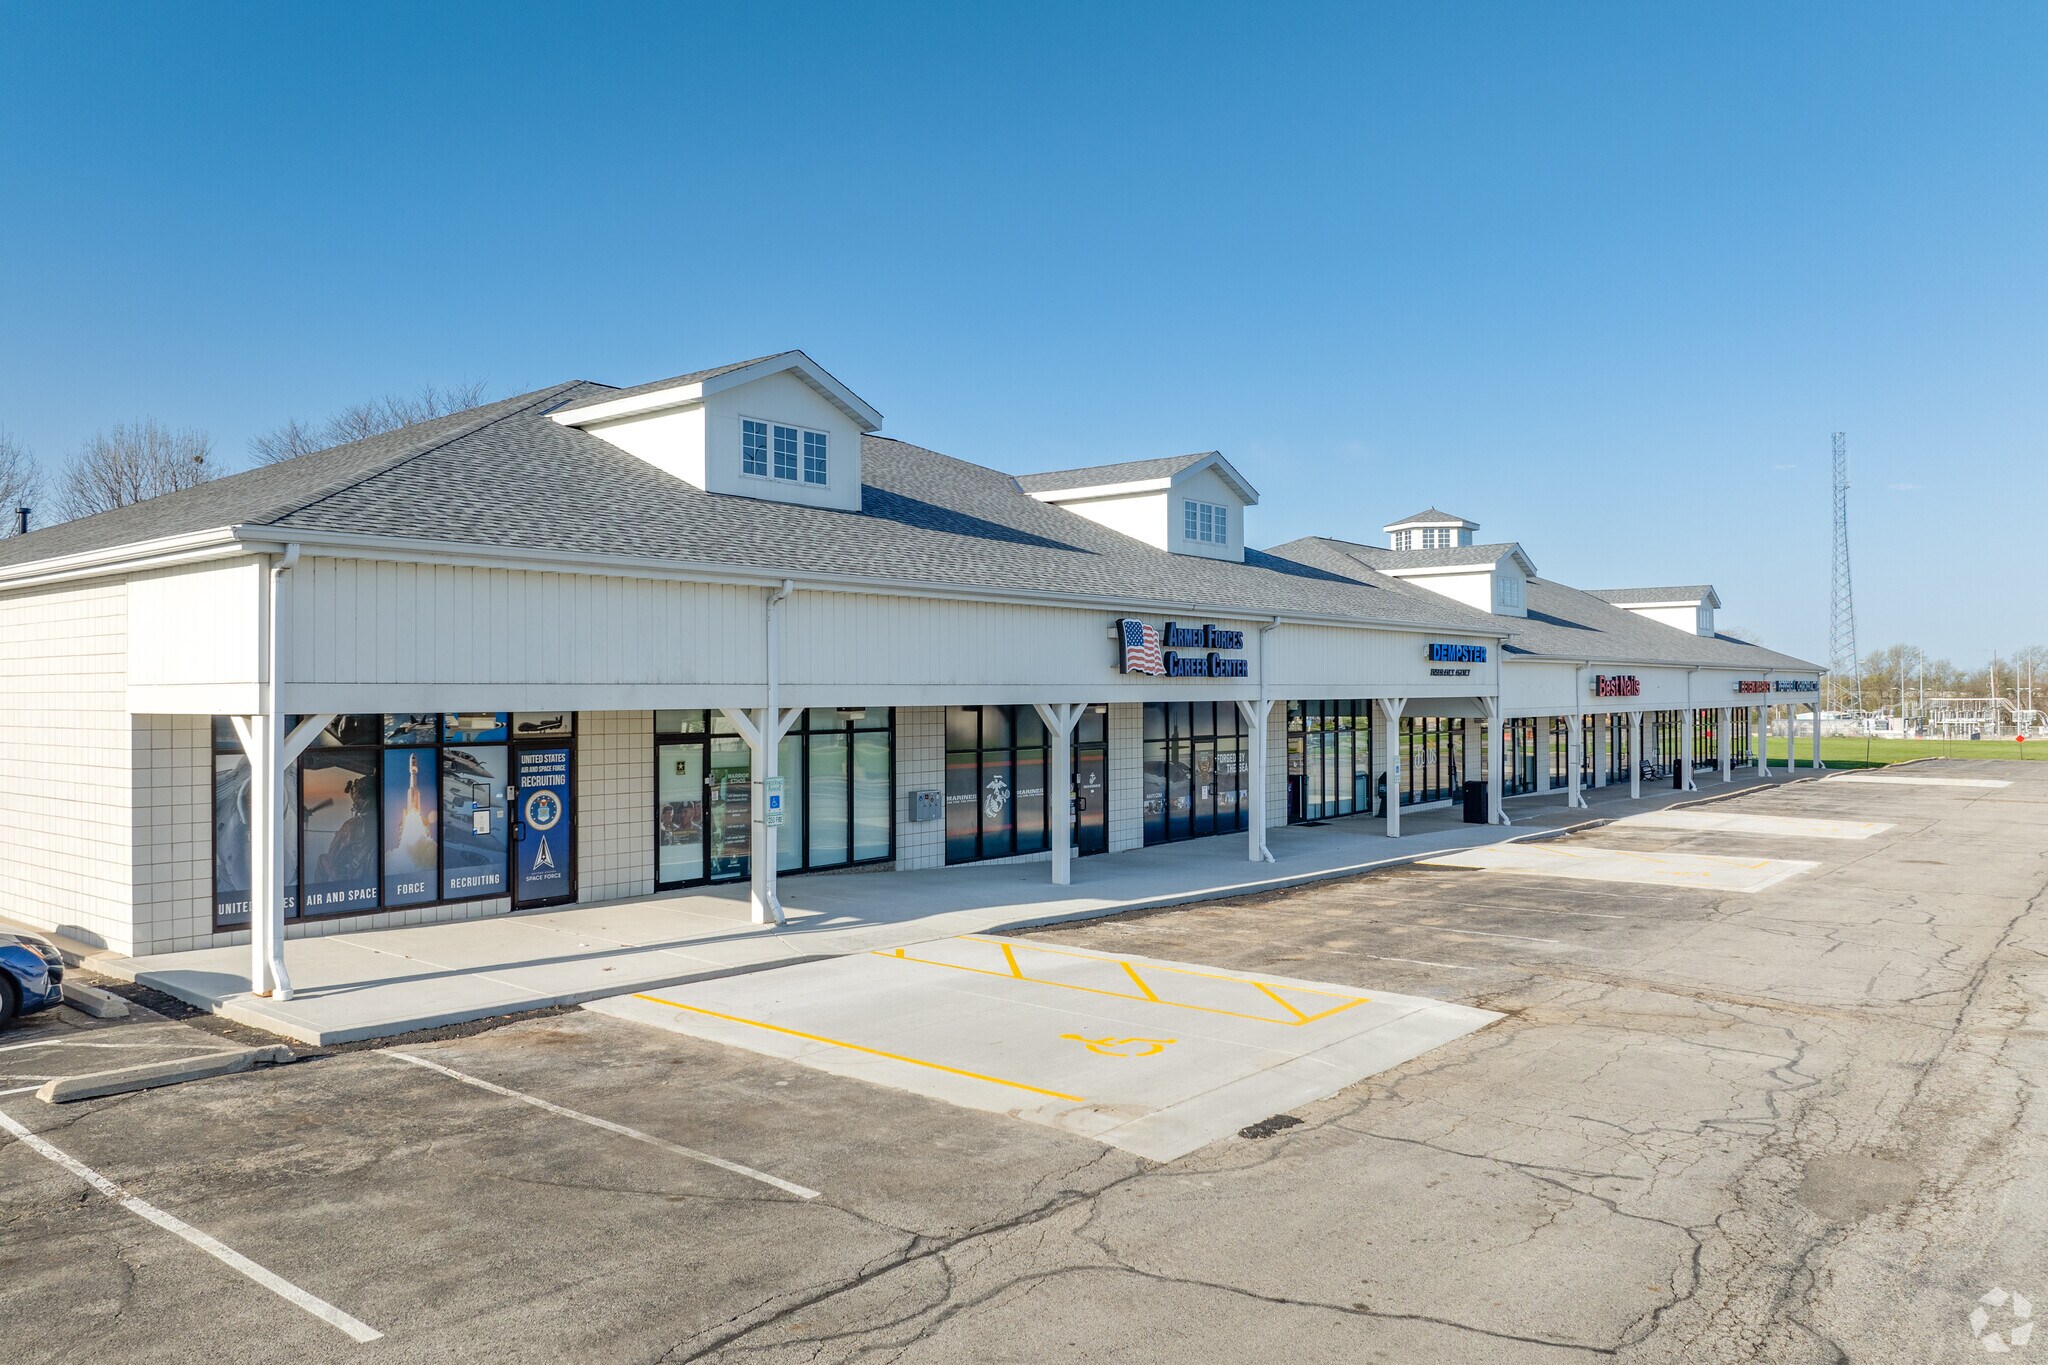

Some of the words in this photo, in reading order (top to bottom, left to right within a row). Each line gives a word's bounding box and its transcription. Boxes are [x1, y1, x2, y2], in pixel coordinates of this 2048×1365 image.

[1165, 622, 1204, 648] ARMED
[1207, 624, 1243, 649] FORCES
[1431, 644, 1487, 663] DEMPSTER
[1168, 651, 1208, 677] CAREER
[1211, 653, 1248, 677] CENTER
[1599, 675, 1619, 697] Best
[1619, 675, 1640, 697] Nails
[521, 755, 543, 764] UNITED
[544, 753, 566, 763] STATES
[1217, 753, 1236, 763] FORGED
[552, 764, 566, 772] FORCE
[1226, 763, 1236, 773] THE
[521, 774, 566, 788] RECRUITING
[946, 794, 977, 802] MARINES
[1016, 788, 1044, 796] MARINES
[306, 894, 323, 906] AIR
[326, 891, 345, 904] AND
[348, 887, 377, 901] SPACE
[397, 882, 425, 895] FORCE
[450, 874, 500, 889] RECRUITING
